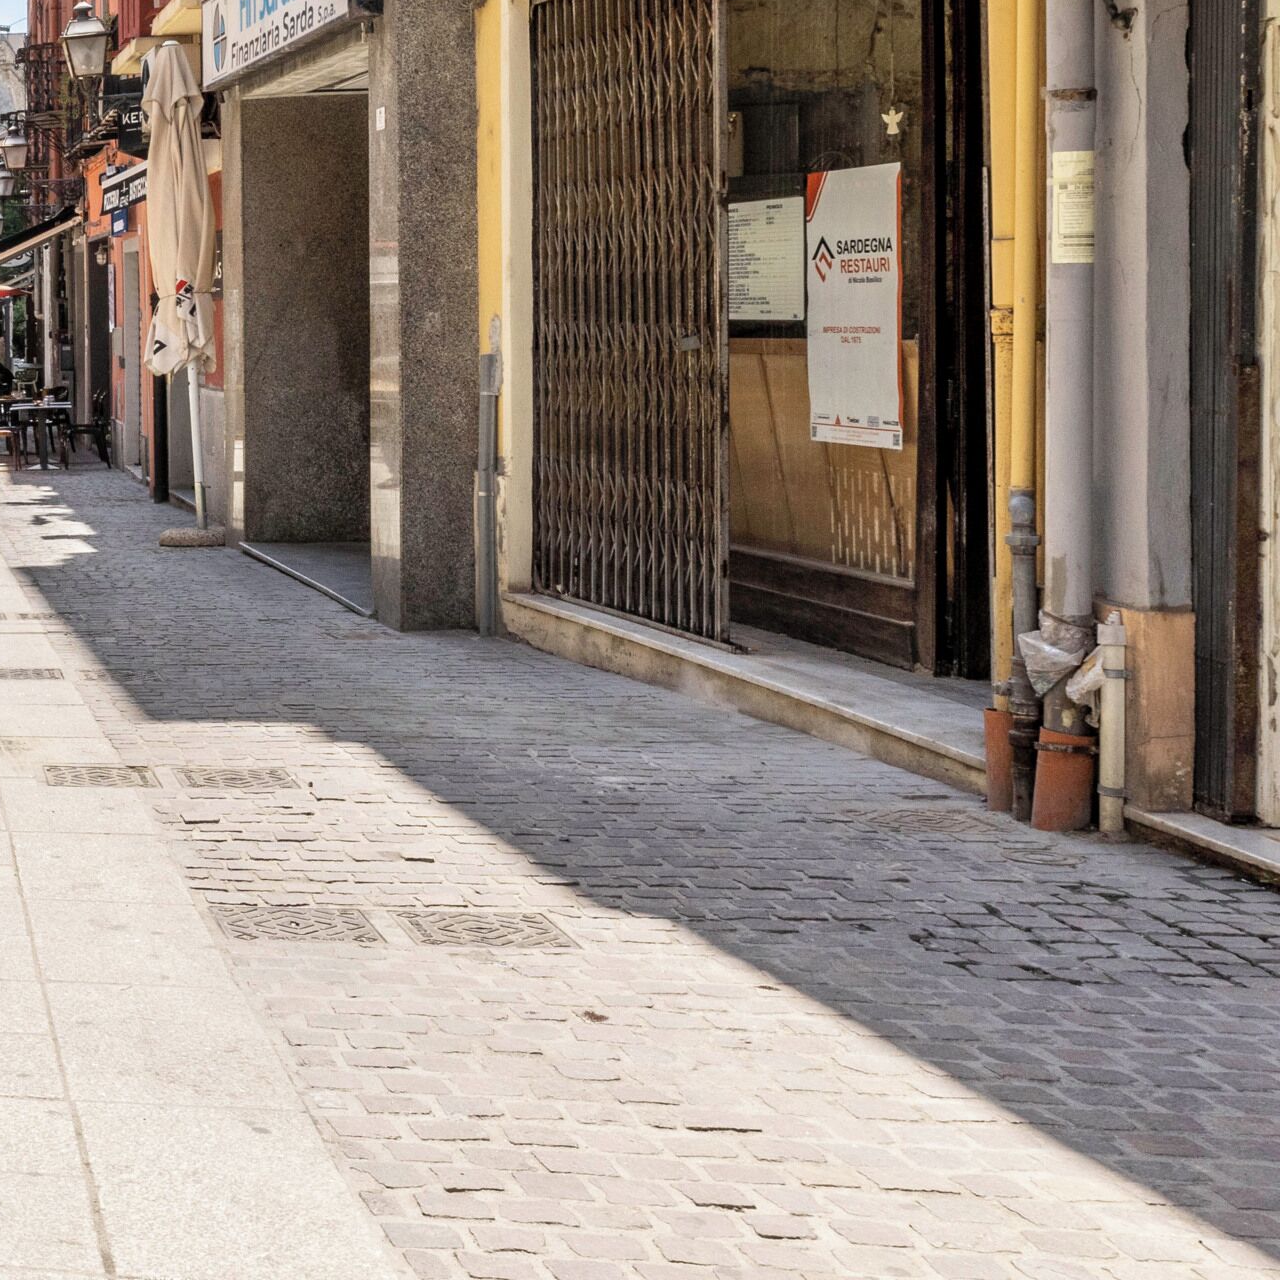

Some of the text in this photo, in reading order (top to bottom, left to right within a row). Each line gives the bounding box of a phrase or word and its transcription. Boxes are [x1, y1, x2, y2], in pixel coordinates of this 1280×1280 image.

[231, 20, 280, 69] Finanziaria
[283, 1, 314, 42] Sarda
[836, 236, 893, 255] SARDEGNA
[840, 257, 891, 273] RESTAURI
